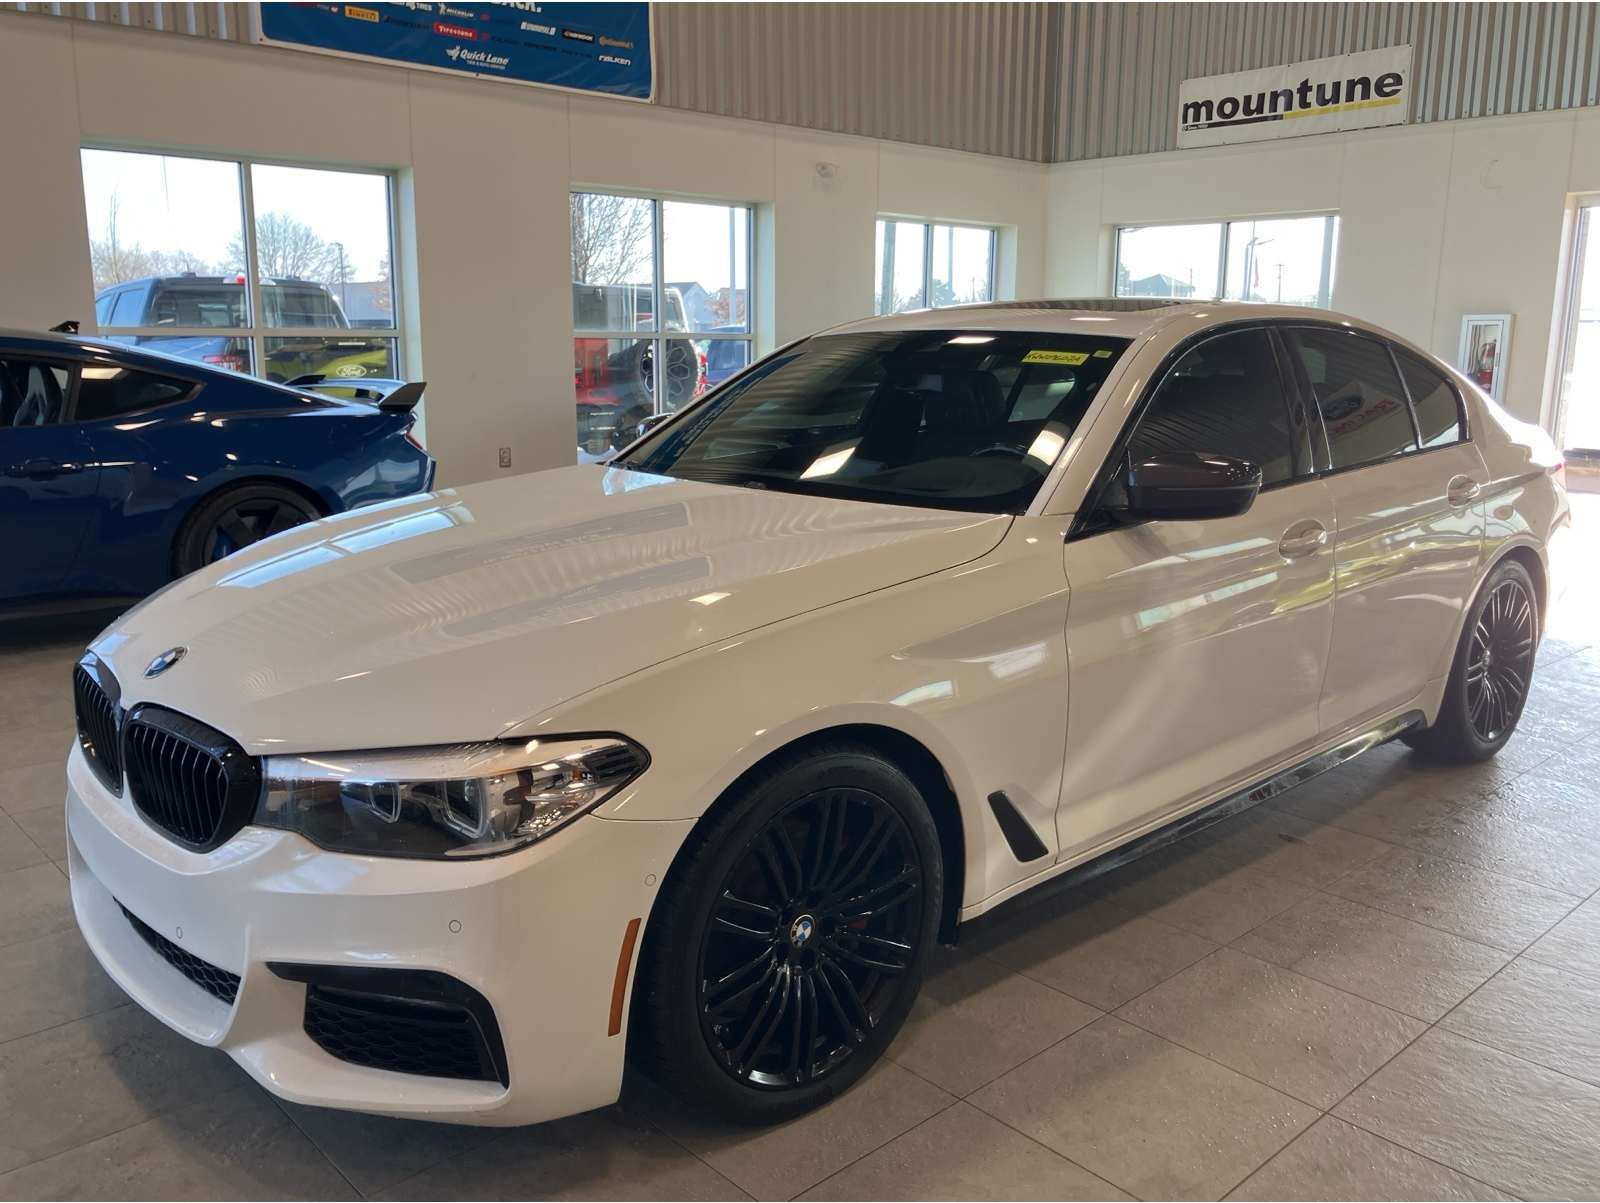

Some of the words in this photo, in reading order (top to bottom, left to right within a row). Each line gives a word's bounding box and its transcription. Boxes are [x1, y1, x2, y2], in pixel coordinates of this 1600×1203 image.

[460, 48, 486, 61] Quick
[486, 53, 510, 66] Lane
[1182, 72, 1403, 124] mountune
